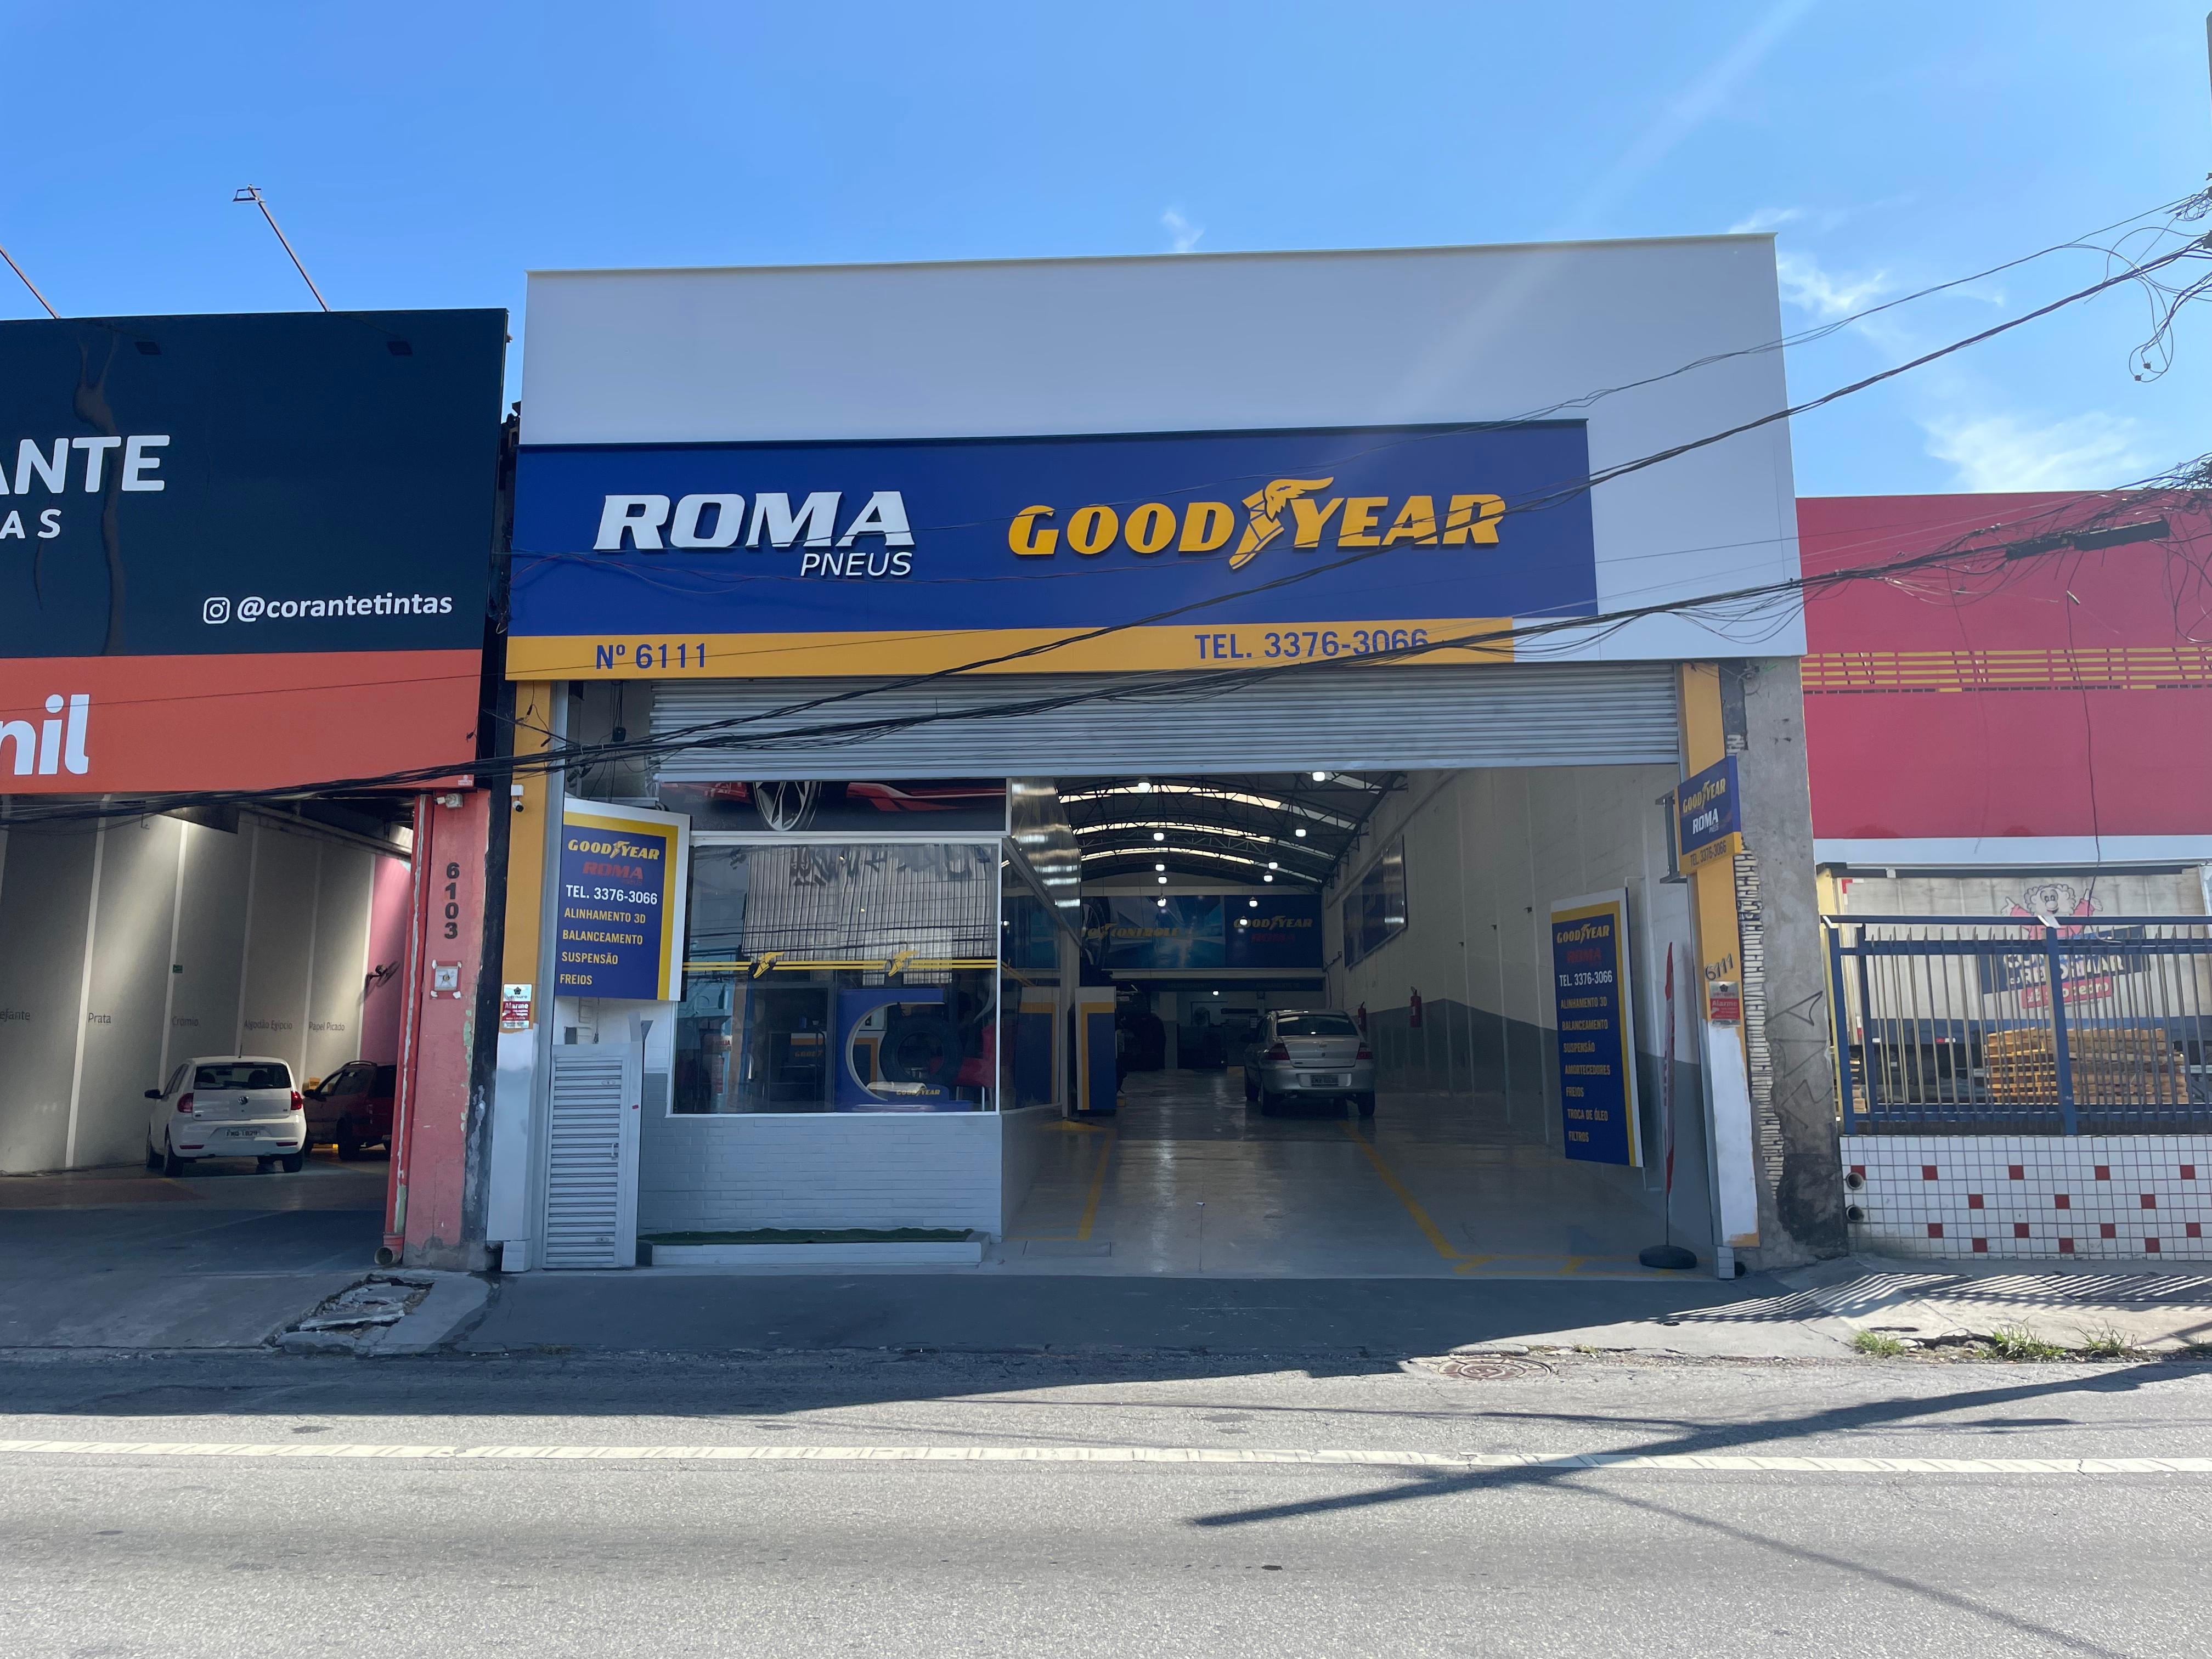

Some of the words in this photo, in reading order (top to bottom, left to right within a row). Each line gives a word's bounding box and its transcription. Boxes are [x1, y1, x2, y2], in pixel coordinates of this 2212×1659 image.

[0, 435, 170, 495] NTE
[592, 492, 915, 549] ROMA
[800, 552, 912, 577] PNEUS
[237, 592, 453, 622] @corantetintas
[1194, 633, 1252, 659] TEL.
[1264, 629, 1429, 657] 3376-3066
[636, 643, 705, 669] 6111
[1683, 778, 1726, 814] GOODYEAR
[1692, 808, 1719, 834] ROMA
[568, 839, 660, 860] GOODYEAR
[1700, 840, 1727, 864] 3376-3066
[583, 861, 643, 880] ROMA
[444, 862, 460, 939] 6103
[566, 884, 590, 899] TEL.
[593, 887, 658, 905] 3376-3066
[564, 907, 631, 923] ALINHAMENTO
[634, 913, 646, 924] 3D
[562, 929, 643, 945] BALANCEAMENTO
[1557, 924, 1610, 943] GOODYEAR
[561, 951, 618, 964] SUSPENSÃO
[1706, 953, 1734, 980] 6111
[560, 974, 592, 985] FREIOS
[1559, 974, 1573, 987] TEL.
[1574, 970, 1612, 986] 3376-3066
[1561, 997, 1598, 1009] ALINHAMENTO
[1599, 996, 1607, 1006] 3D
[88, 1012, 111, 1024] Prata
[1562, 1019, 1609, 1031] BALANCEAMENTO
[1564, 1040, 1595, 1052] SUSPENSÃO
[1565, 1064, 1611, 1075] AMORTECEDORES
[1566, 1087, 1584, 1097] FREIOS
[1567, 1109, 1585, 1120] TROCA
[1586, 1110, 1593, 1120] DE
[1594, 1107, 1609, 1122] ÓLEO
[1568, 1131, 1589, 1142] FILTROS
